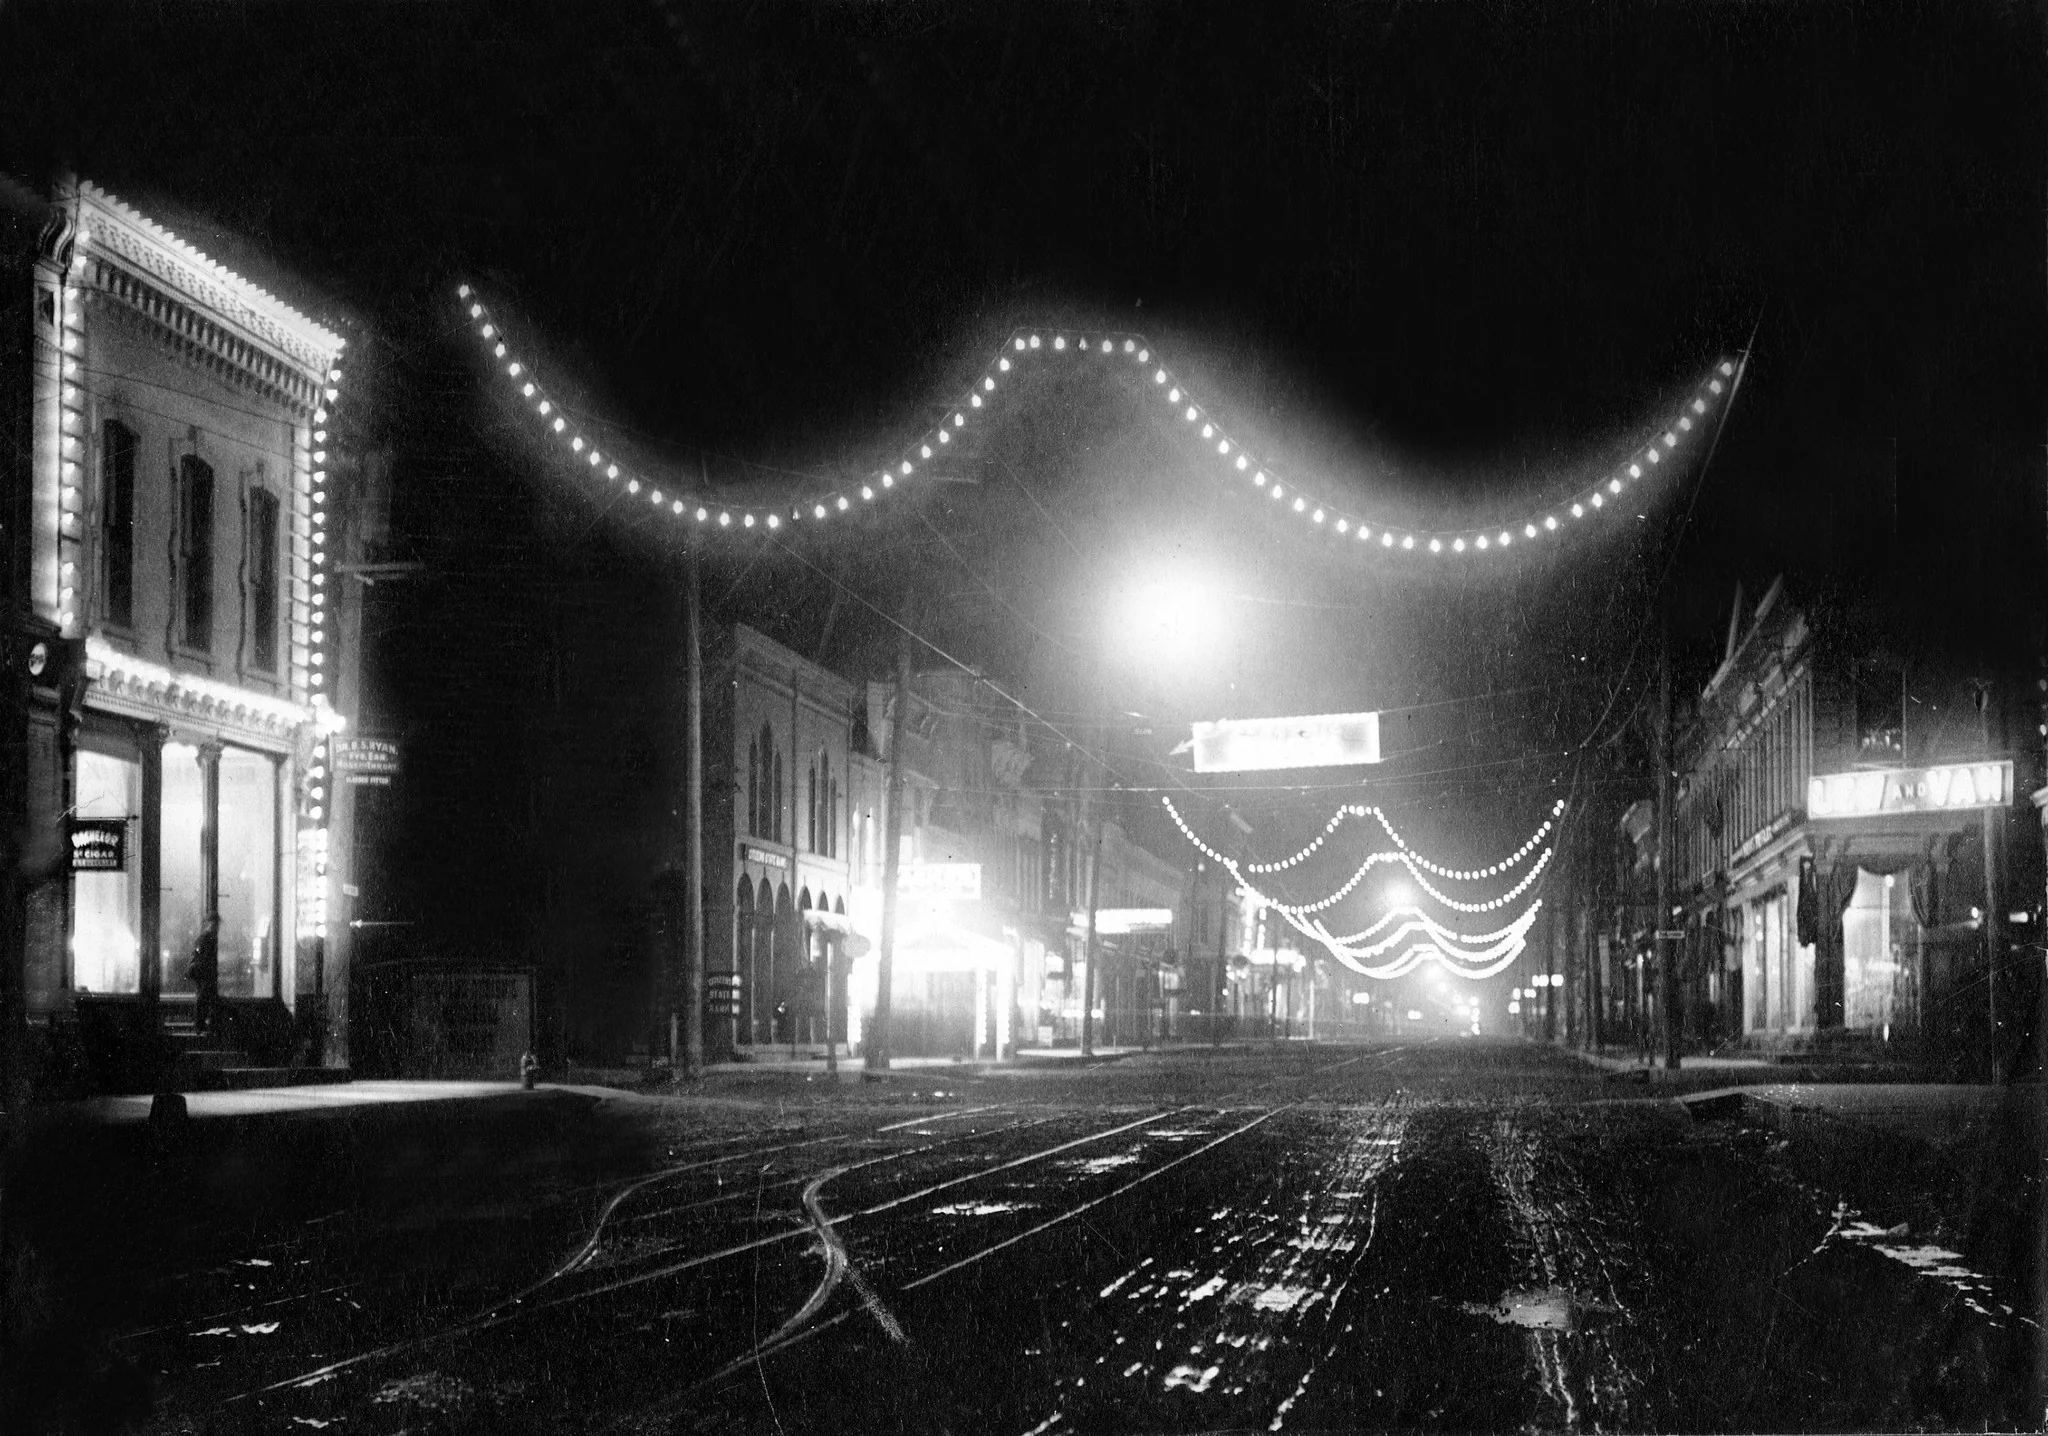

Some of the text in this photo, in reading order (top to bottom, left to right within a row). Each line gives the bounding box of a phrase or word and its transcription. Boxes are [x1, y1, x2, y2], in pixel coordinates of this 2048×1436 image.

[1891, 782, 1927, 800] AND
[1926, 764, 2003, 807] VAN
[84, 850, 115, 859] CIGAR
